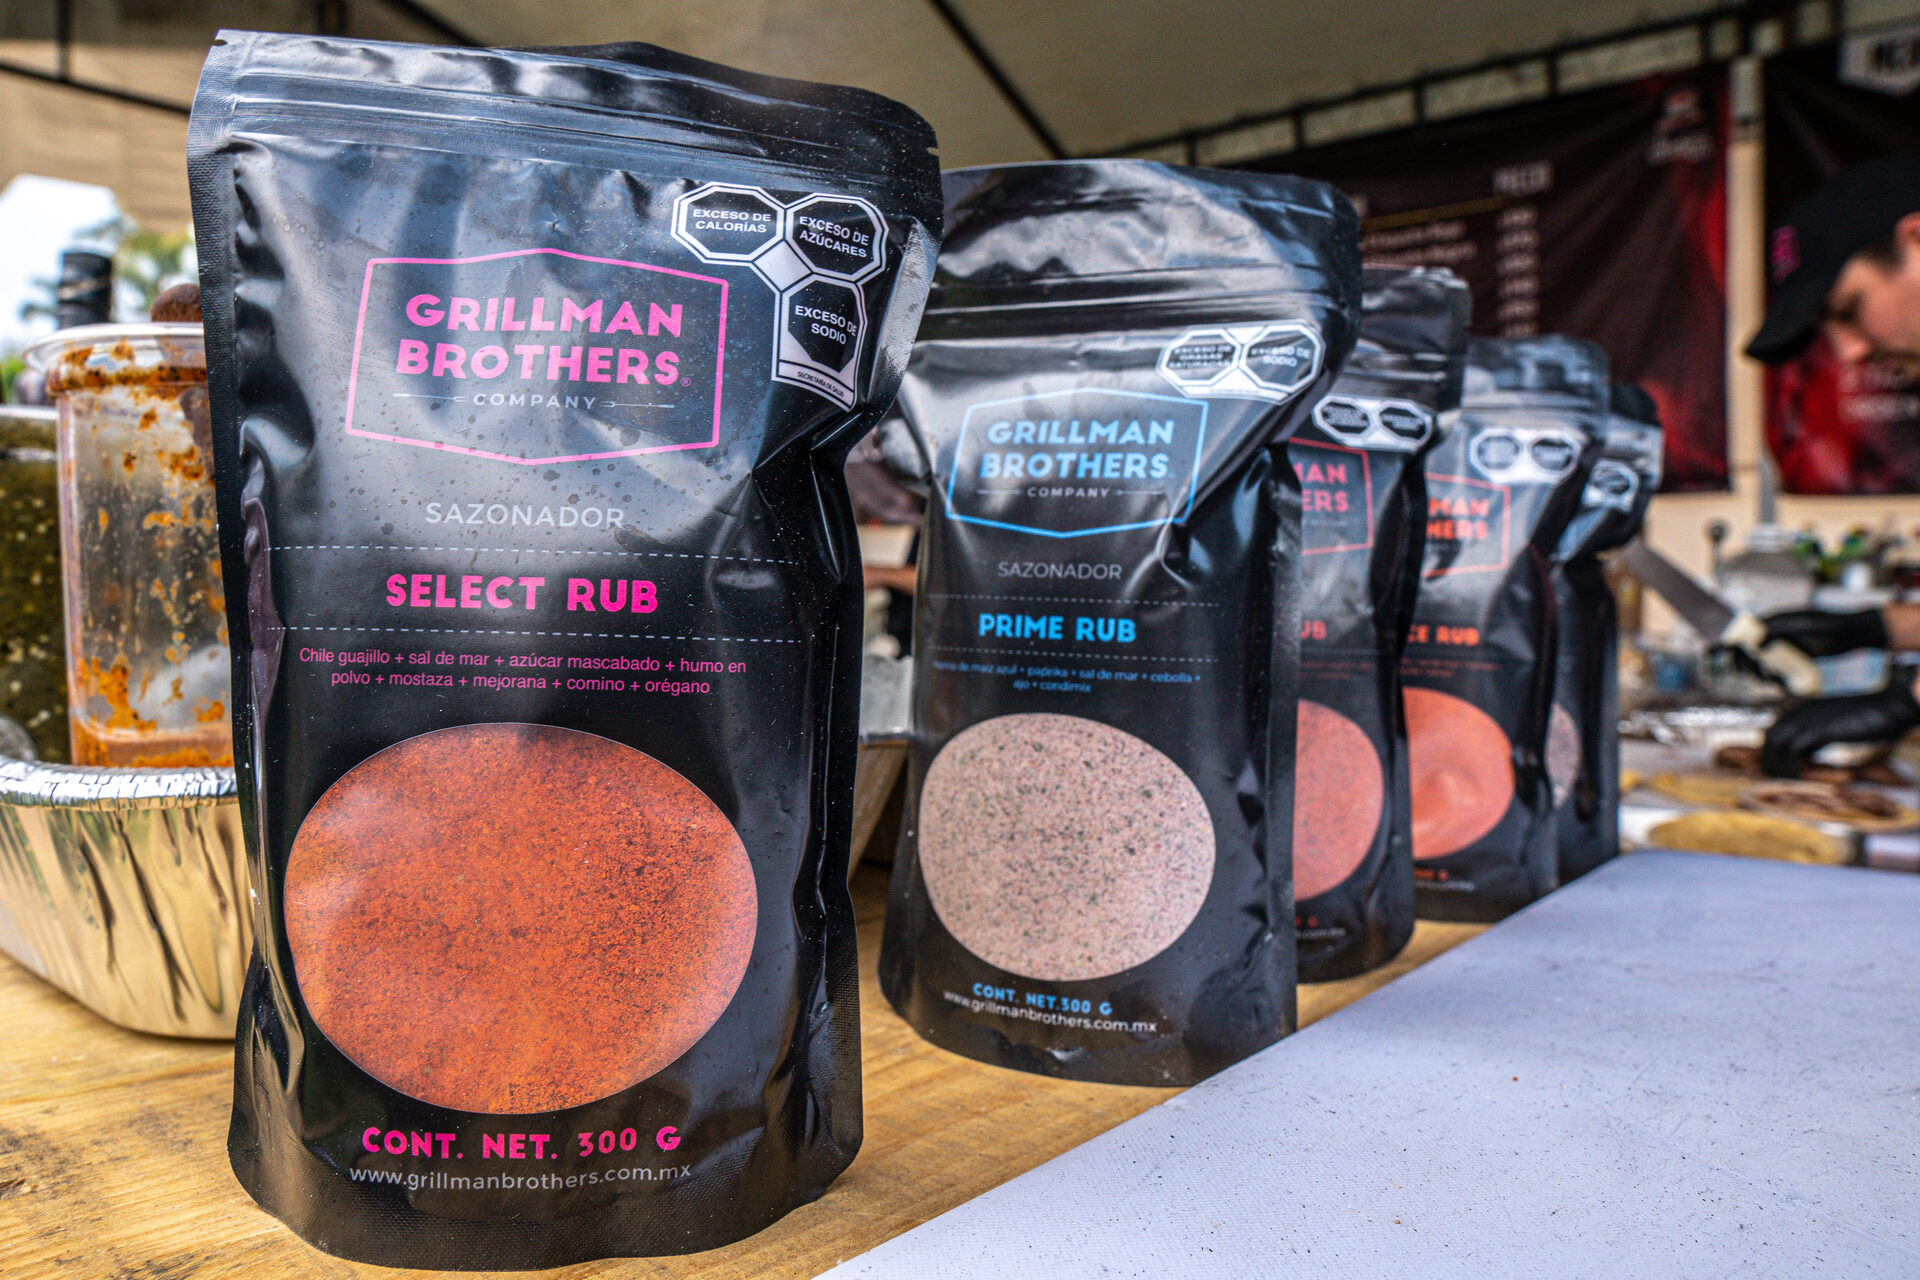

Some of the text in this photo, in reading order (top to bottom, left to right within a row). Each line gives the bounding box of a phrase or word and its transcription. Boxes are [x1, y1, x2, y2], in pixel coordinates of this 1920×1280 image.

[693, 209, 772, 223] EXCESO DE
[695, 220, 767, 233] CALORÍAS
[799, 216, 870, 246] EXCESO DE
[799, 230, 867, 258] AZÚCARES
[405, 293, 683, 338] GRILLMAN
[795, 305, 858, 337] EXCESO DE
[811, 323, 847, 345] SODIO
[473, 392, 597, 411] COMPANY
[987, 420, 1175, 446] GRILLMAN
[980, 452, 1170, 479] BROTHERS
[1027, 486, 1111, 499] COMPANY
[425, 502, 625, 528] SAZONADOR
[997, 561, 1123, 581] SAZONADOR
[386, 573, 659, 614] SELECT RUB
[978, 613, 1137, 642] PRIME RUB
[299, 647, 334, 663] Chile
[338, 649, 390, 667] guajillo
[408, 650, 431, 665] sal
[435, 650, 455, 665] de
[459, 653, 490, 666] mar
[508, 653, 563, 668] azúcar
[567, 656, 661, 672] mascabado
[680, 658, 724, 673] humo
[728, 661, 747, 673] en
[331, 670, 371, 687] polvo
[388, 672, 454, 687] mostaza
[473, 674, 547, 691] mejorana
[566, 676, 625, 691] comino
[644, 678, 711, 696] orégano
[943, 989, 1158, 1033] www.grillmanbrothers.com.mx
[972, 982, 1020, 1004] CONT.
[1099, 1001, 1113, 1016] G
[362, 1125, 682, 1160] CONT. NET. 300 G
[349, 1163, 692, 1192] www.grillmanbrothers.com.mx
